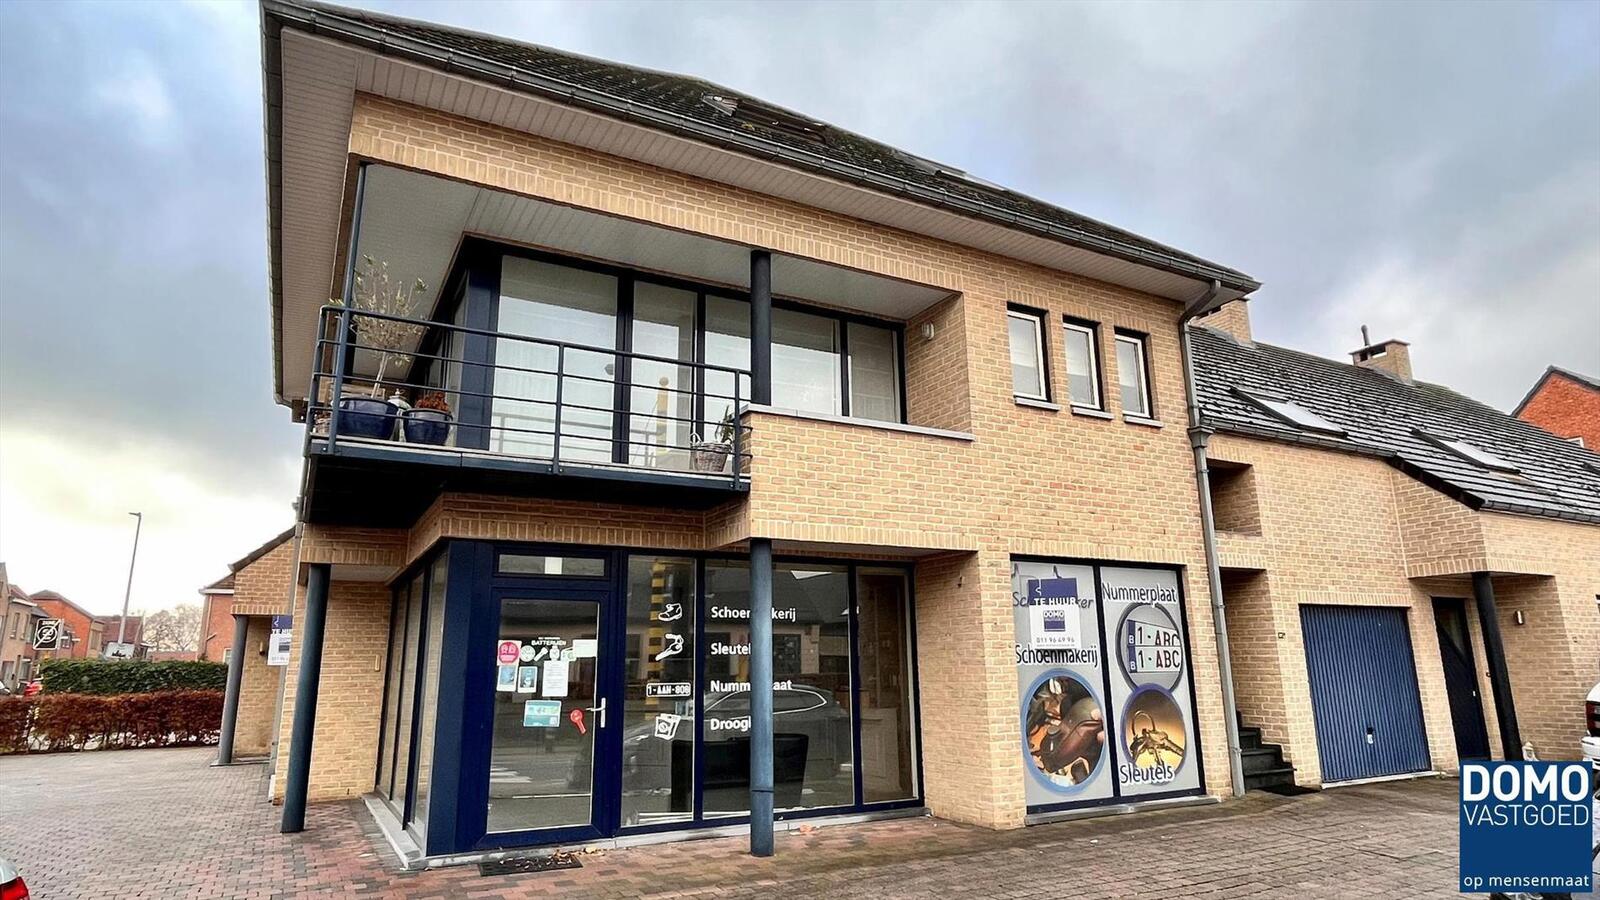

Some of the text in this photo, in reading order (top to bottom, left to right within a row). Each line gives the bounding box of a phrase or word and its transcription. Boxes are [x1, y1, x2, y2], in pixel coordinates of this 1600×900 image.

[1049, 597, 1076, 605] HUUR
[1102, 583, 1177, 607] Nummerplaat
[711, 606, 796, 622] Schoekerij
[711, 642, 751, 655] Sleutel
[1016, 645, 1098, 668] Schoenmakerij
[711, 680, 792, 692] Nummaat
[1120, 764, 1173, 783] Sleutels
